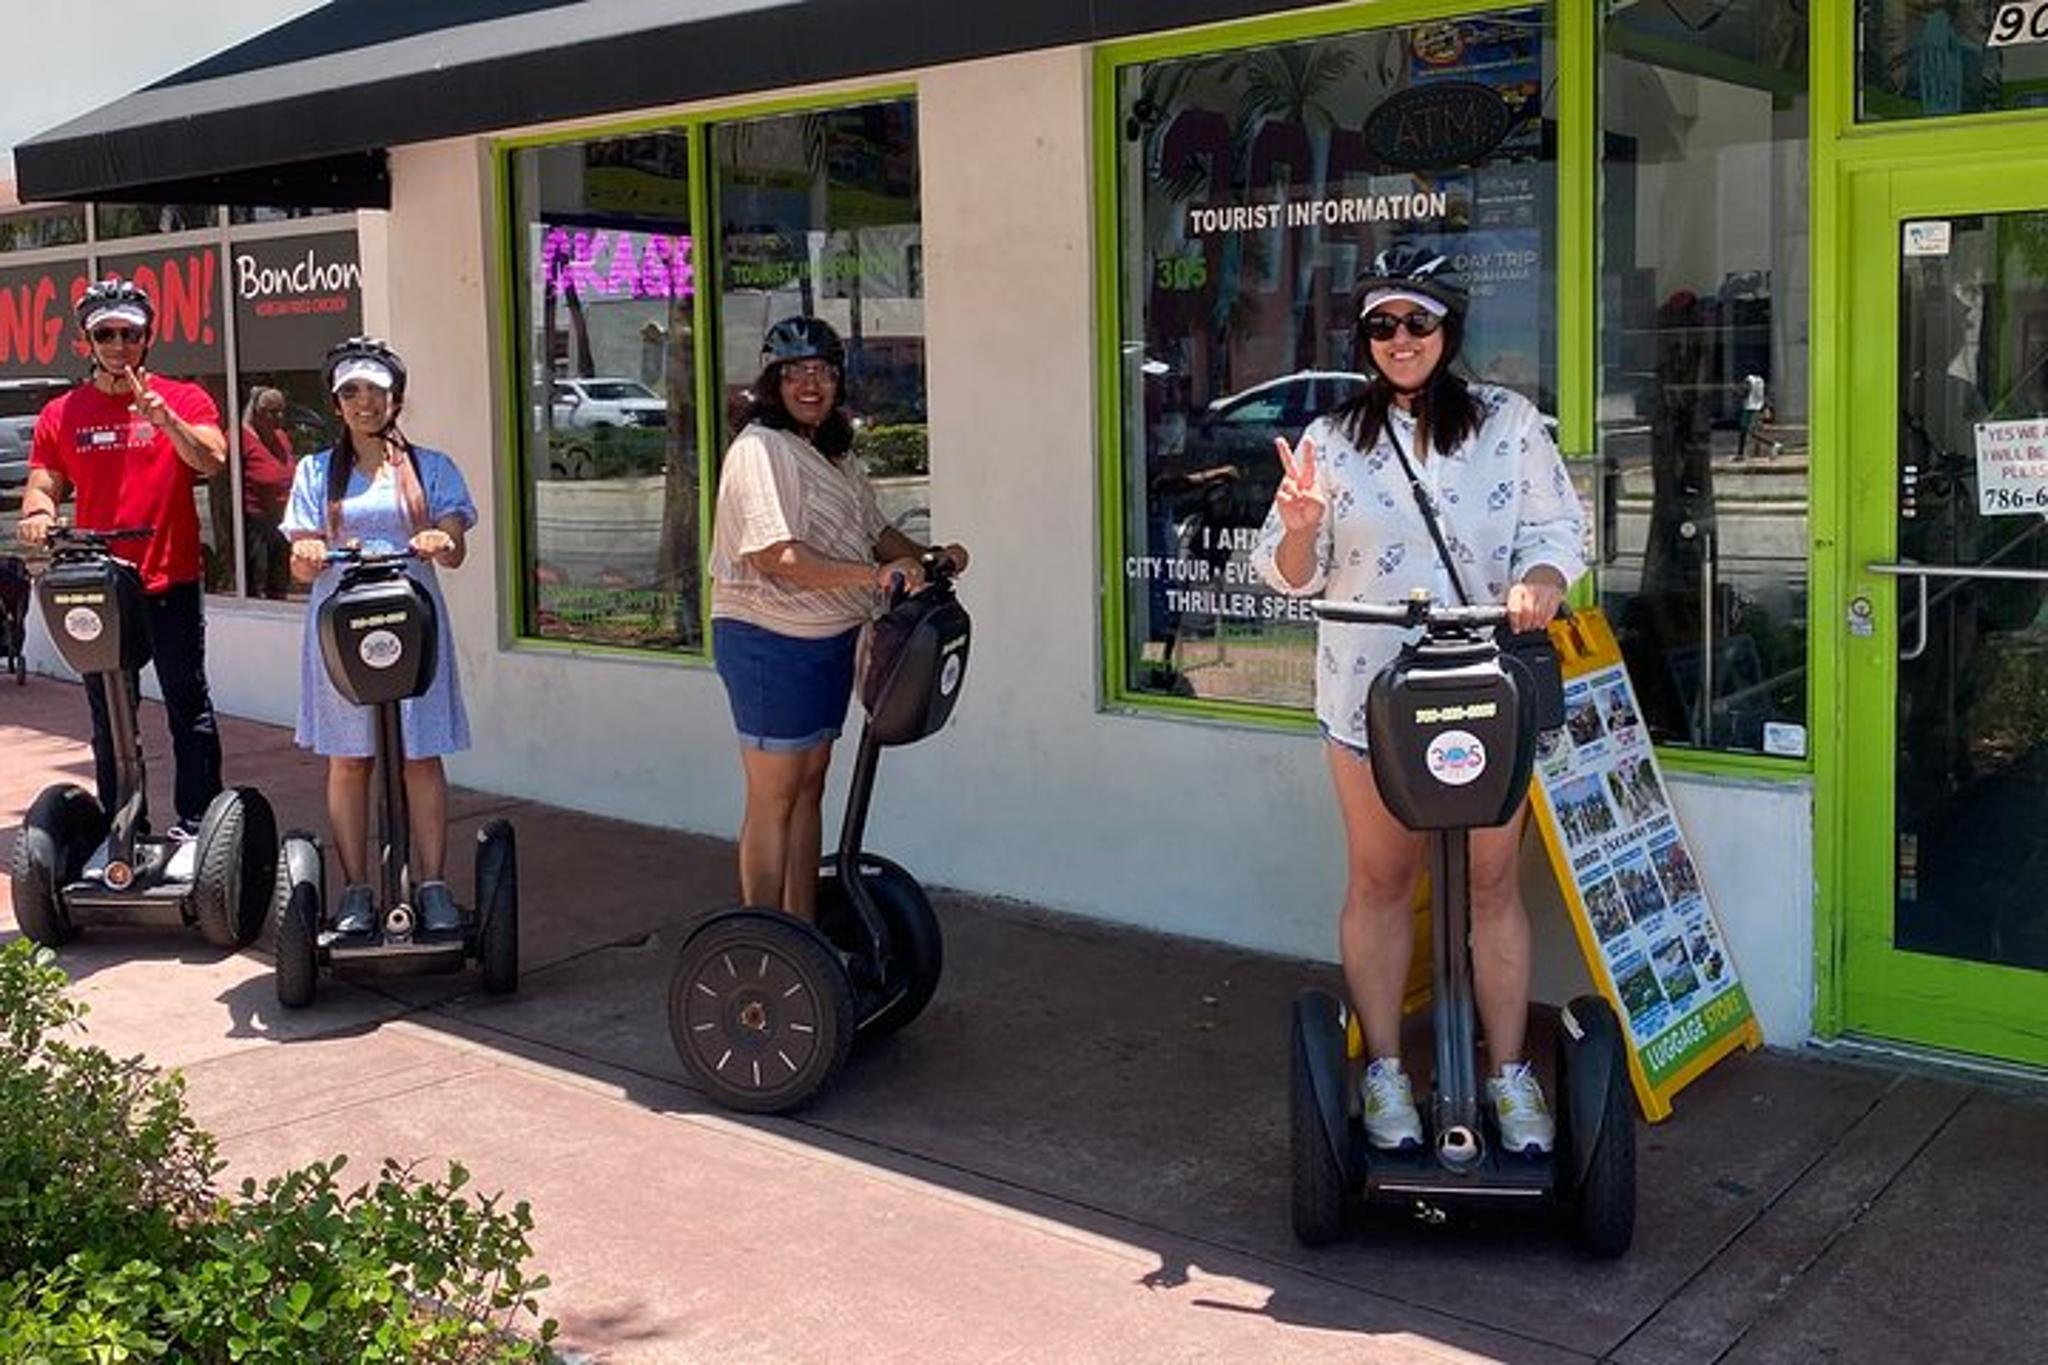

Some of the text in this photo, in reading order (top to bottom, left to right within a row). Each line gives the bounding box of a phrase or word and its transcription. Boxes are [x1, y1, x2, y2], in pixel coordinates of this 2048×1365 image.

[1190, 193, 1447, 234] TOURIST INFORMATION
[236, 249, 363, 299] Bonchon
[1156, 257, 1208, 290] 305
[1494, 248, 1537, 268] TRIP
[1125, 556, 1162, 579] CITY
[1166, 559, 1210, 581] TOUR
[1166, 591, 1319, 621] THRILLER SPEE
[1646, 1014, 1708, 1072] LUGGAGE
